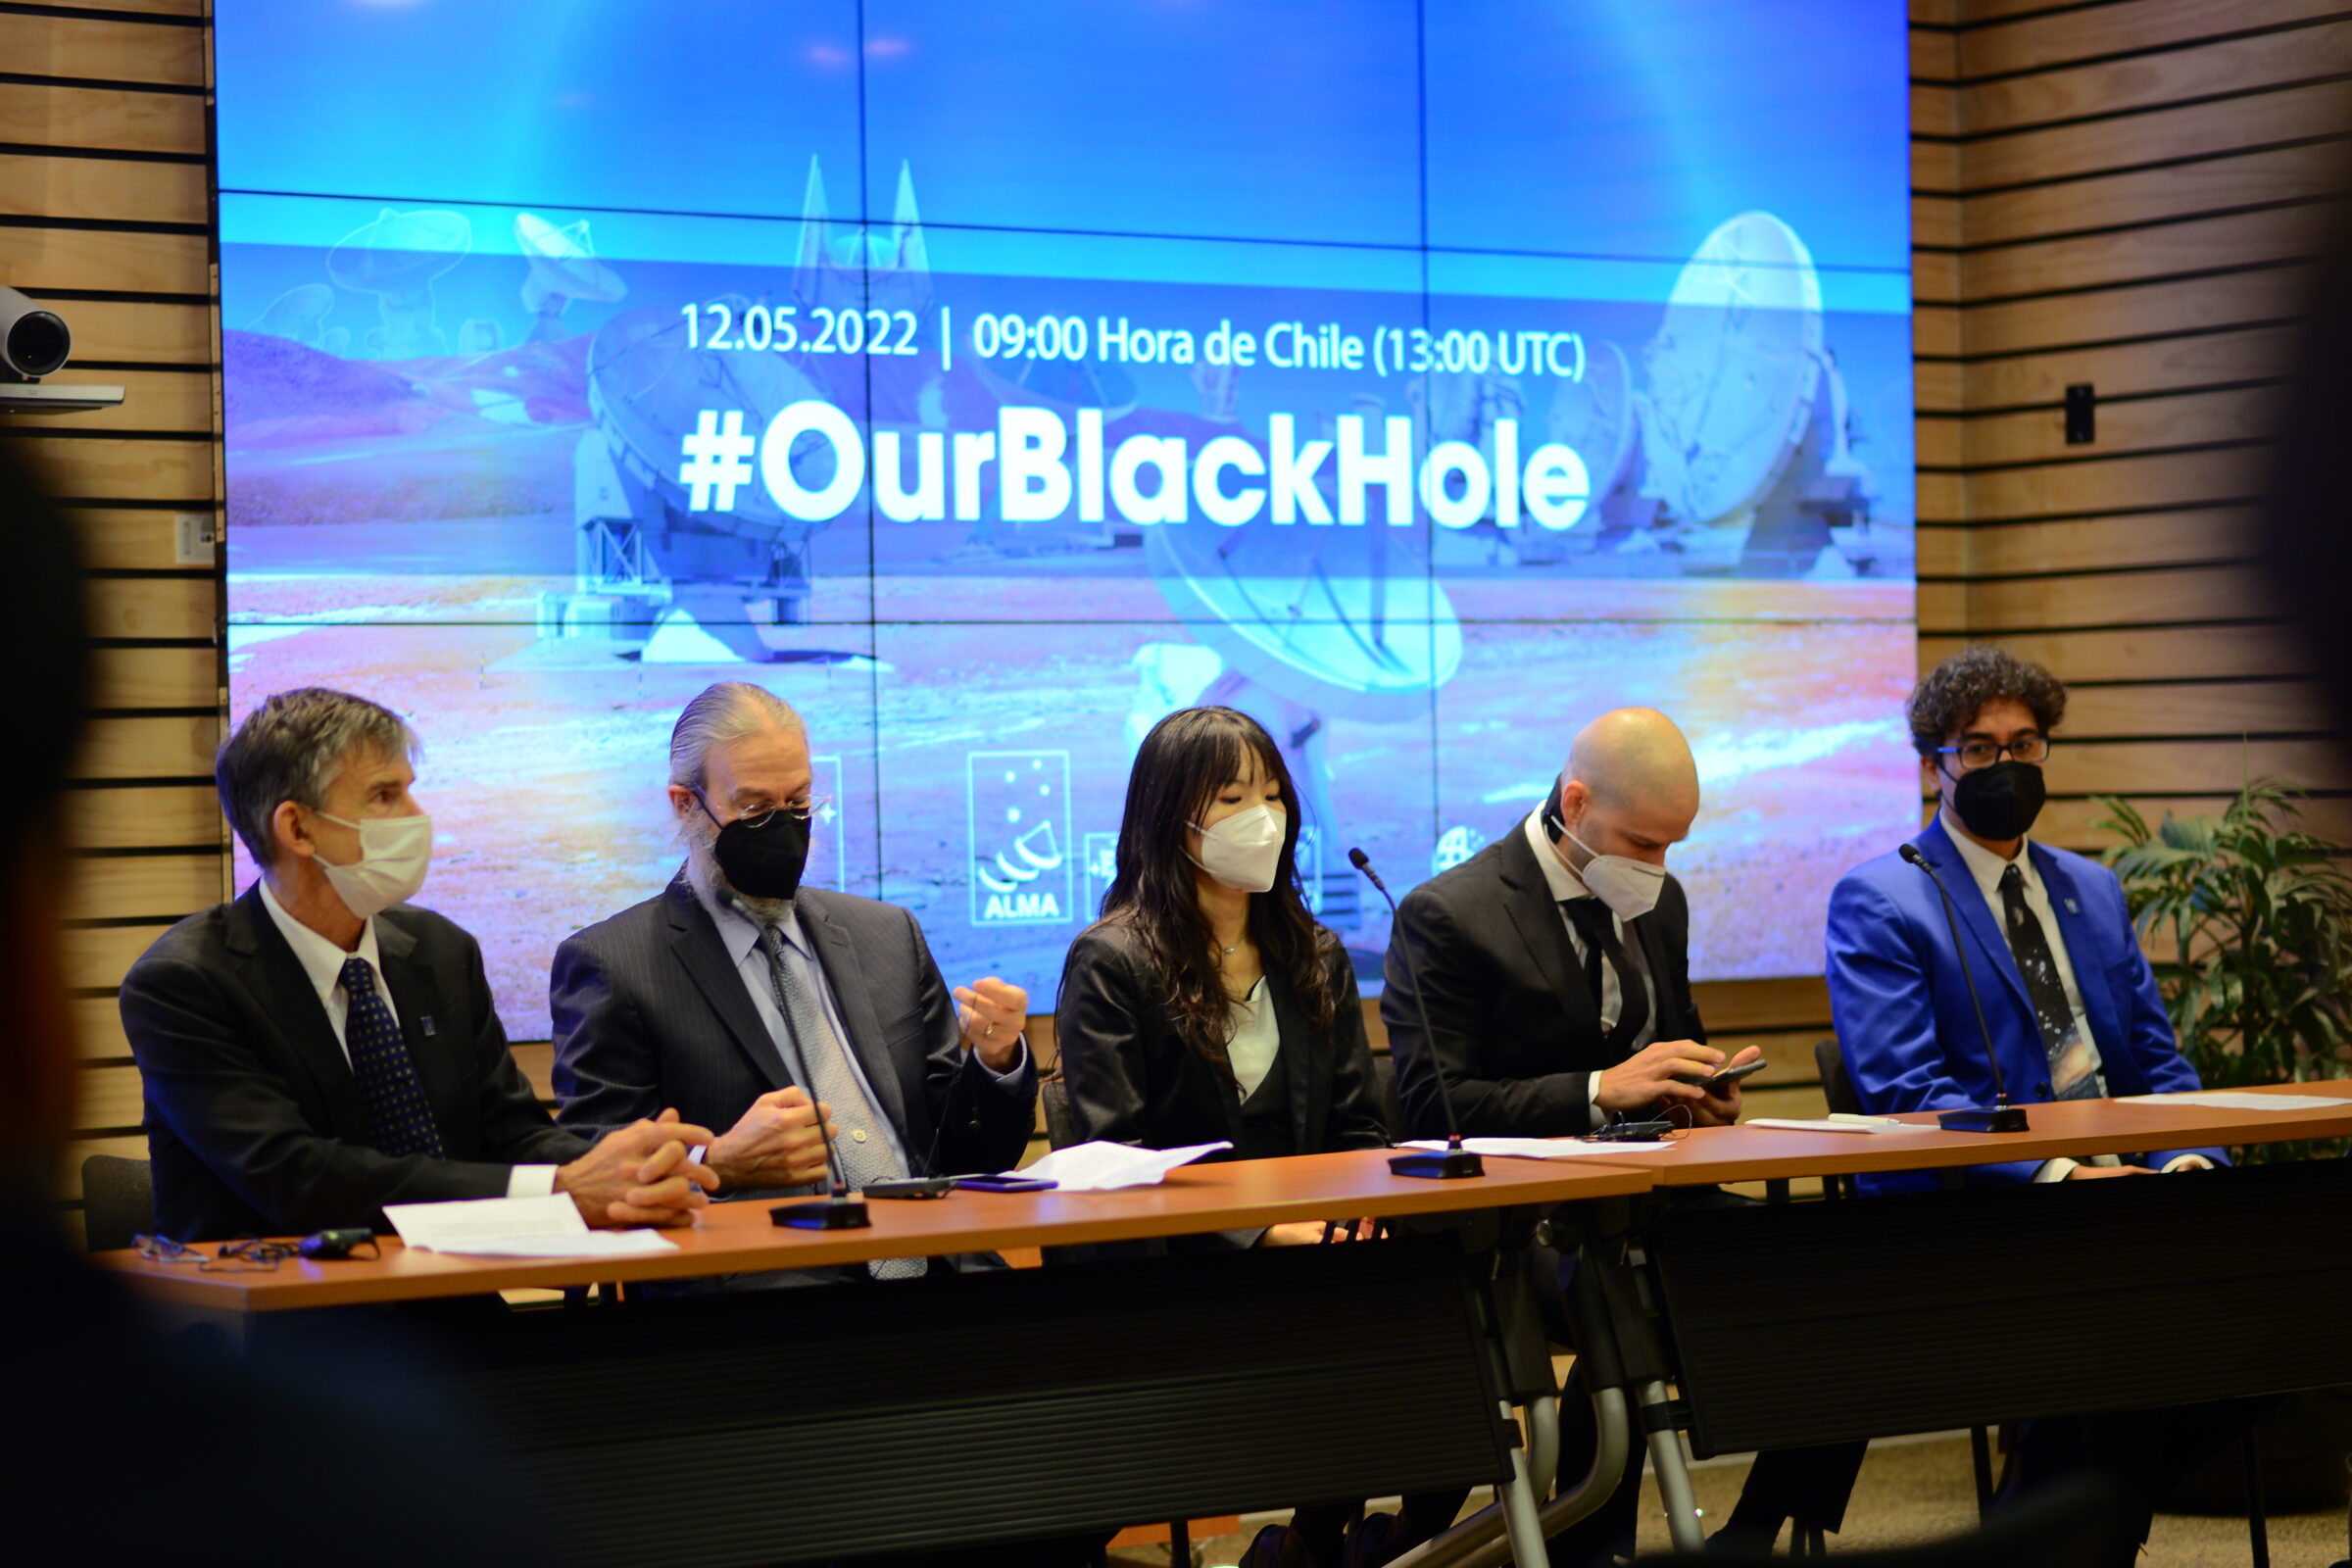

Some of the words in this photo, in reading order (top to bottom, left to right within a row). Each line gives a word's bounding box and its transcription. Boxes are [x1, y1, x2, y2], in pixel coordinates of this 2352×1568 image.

[681, 303, 919, 356] 12.05.2022
[973, 313, 1088, 362] 09:00
[1098, 316, 1195, 364] Hora
[1203, 318, 1256, 367] de
[1264, 321, 1365, 370] Chile
[1373, 325, 1490, 378] (13:00
[1497, 330, 1585, 383] UTC)
[679, 399, 1591, 530] #OurBlackHole
[985, 892, 1060, 919] ALMA
